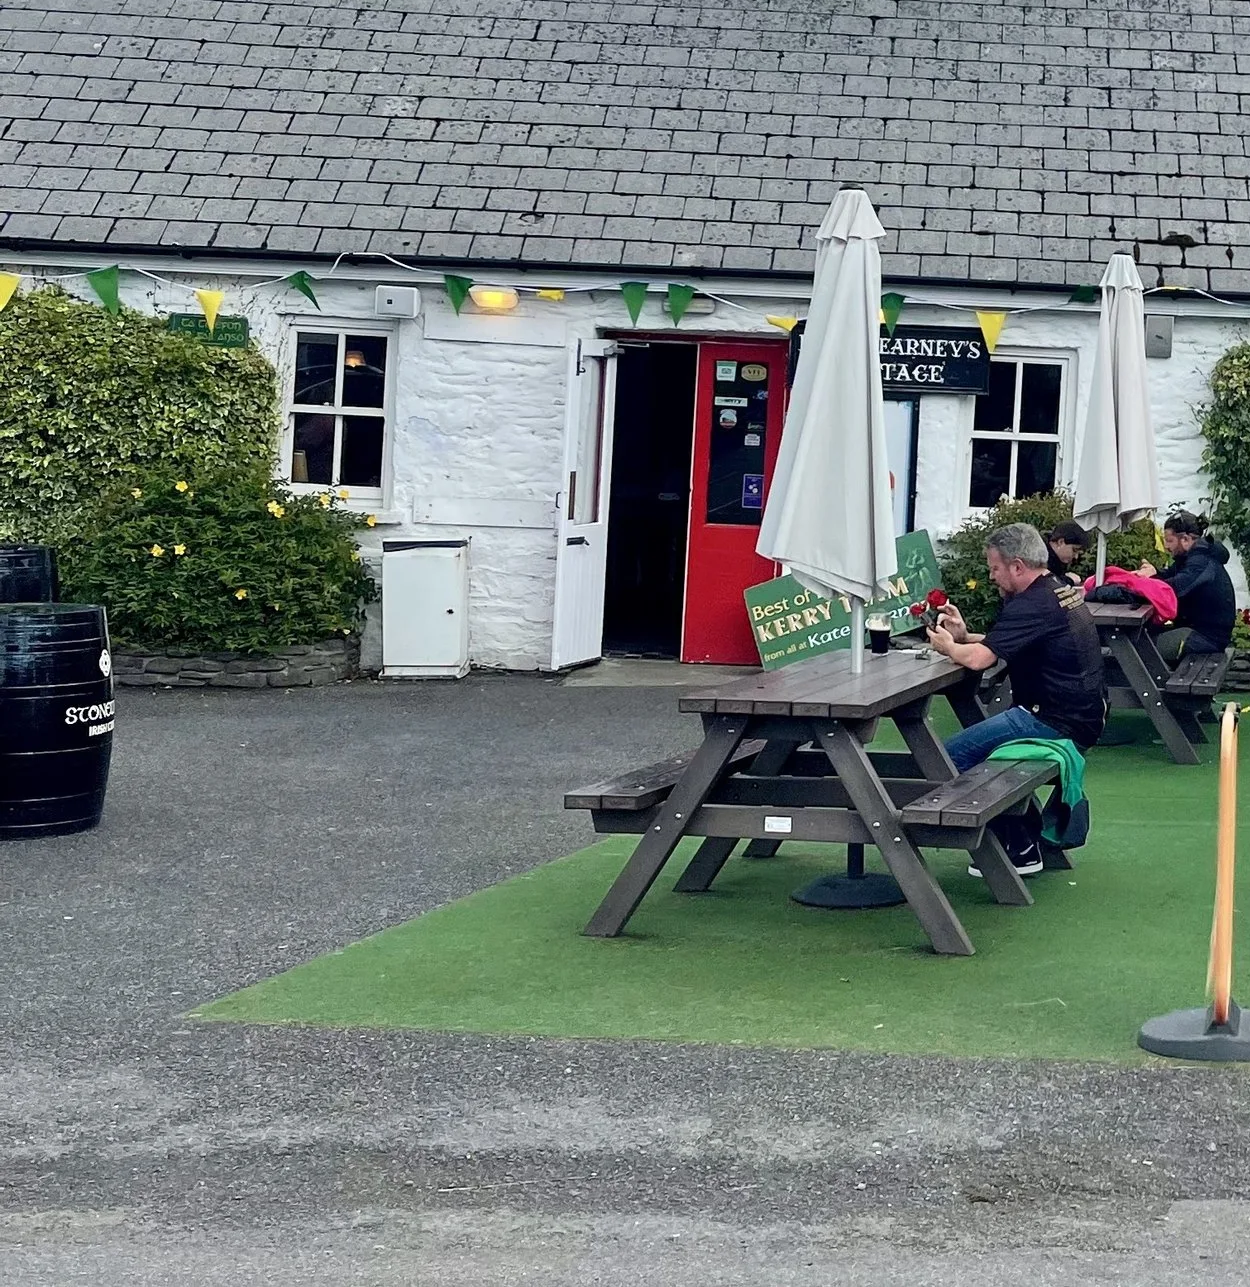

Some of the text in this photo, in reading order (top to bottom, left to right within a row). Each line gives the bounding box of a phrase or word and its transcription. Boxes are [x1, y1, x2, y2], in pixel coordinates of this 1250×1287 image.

[879, 337, 981, 360] EARNEY'S
[881, 362, 945, 384] TAGE
[752, 589, 812, 623] Best of
[756, 600, 833, 644] KERRY
[764, 625, 851, 663] from all at Kate
